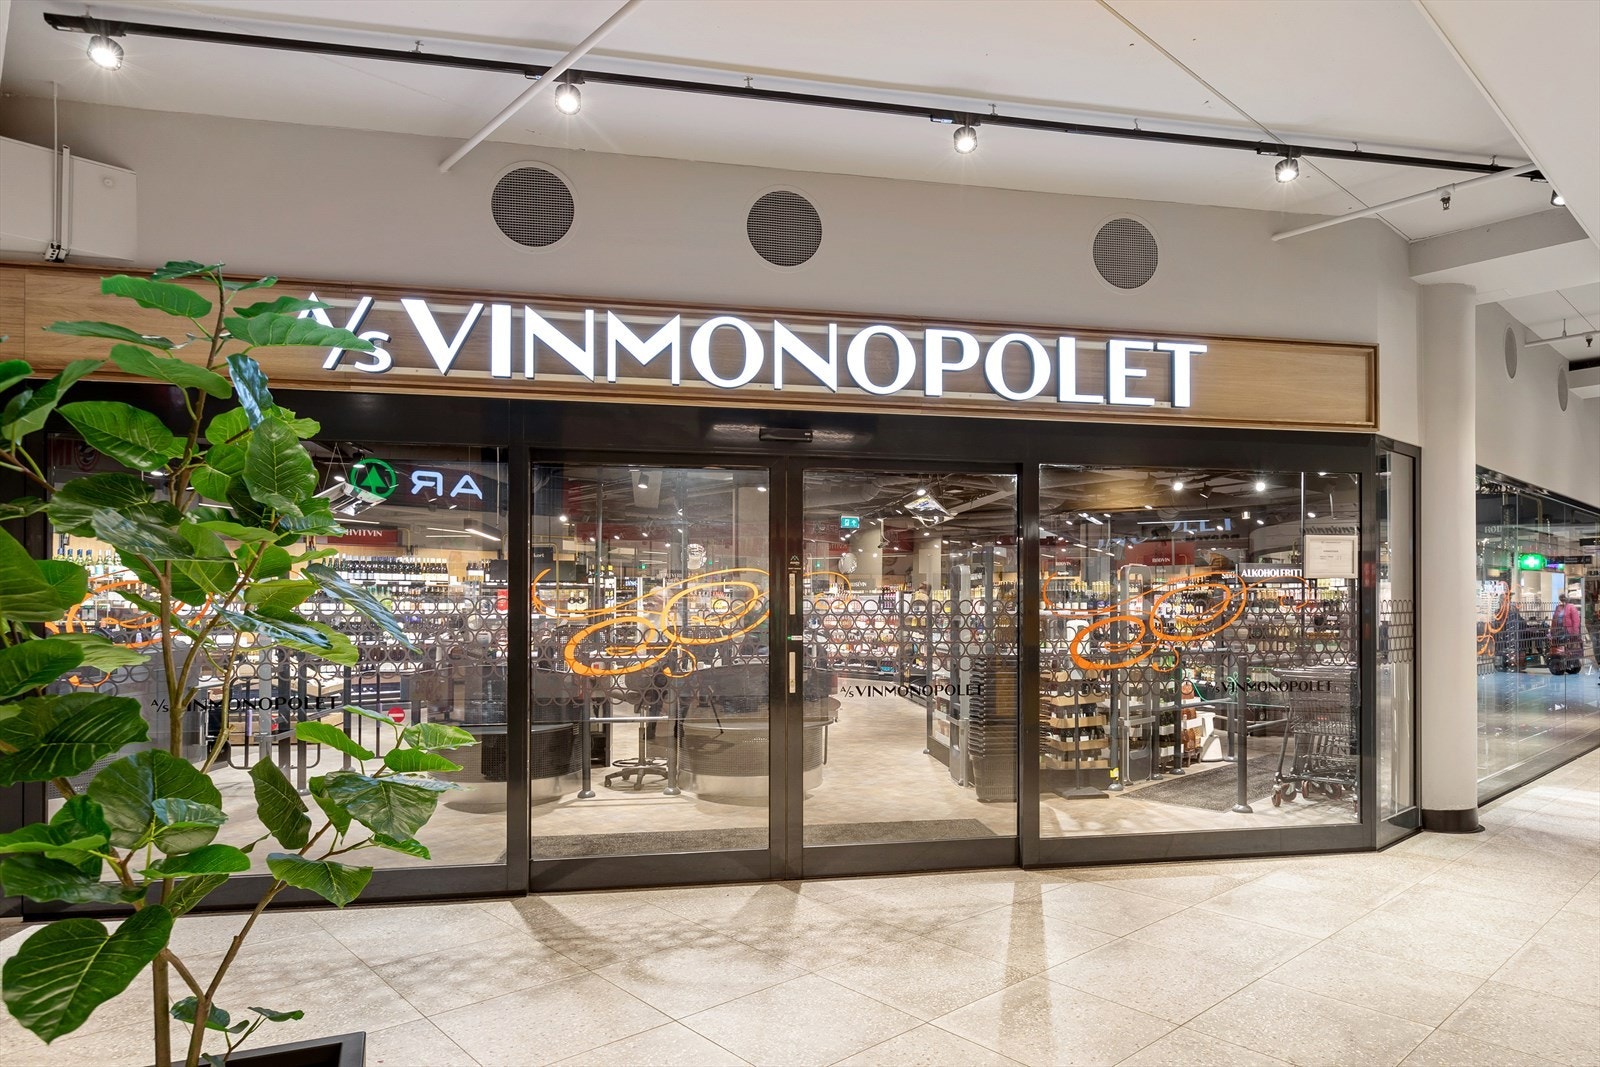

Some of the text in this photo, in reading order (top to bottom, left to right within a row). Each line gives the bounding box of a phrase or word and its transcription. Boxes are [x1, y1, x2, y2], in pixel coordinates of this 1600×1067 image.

[400, 298, 1208, 408] VINMONOPOLET
[1241, 568, 1302, 578] ALKOHOLFRITT
[855, 684, 983, 697] VINMONOPOLET
[1220, 681, 1332, 692] VINMONOPOLET
[150, 697, 336, 712] A/S INMONOPOLET
